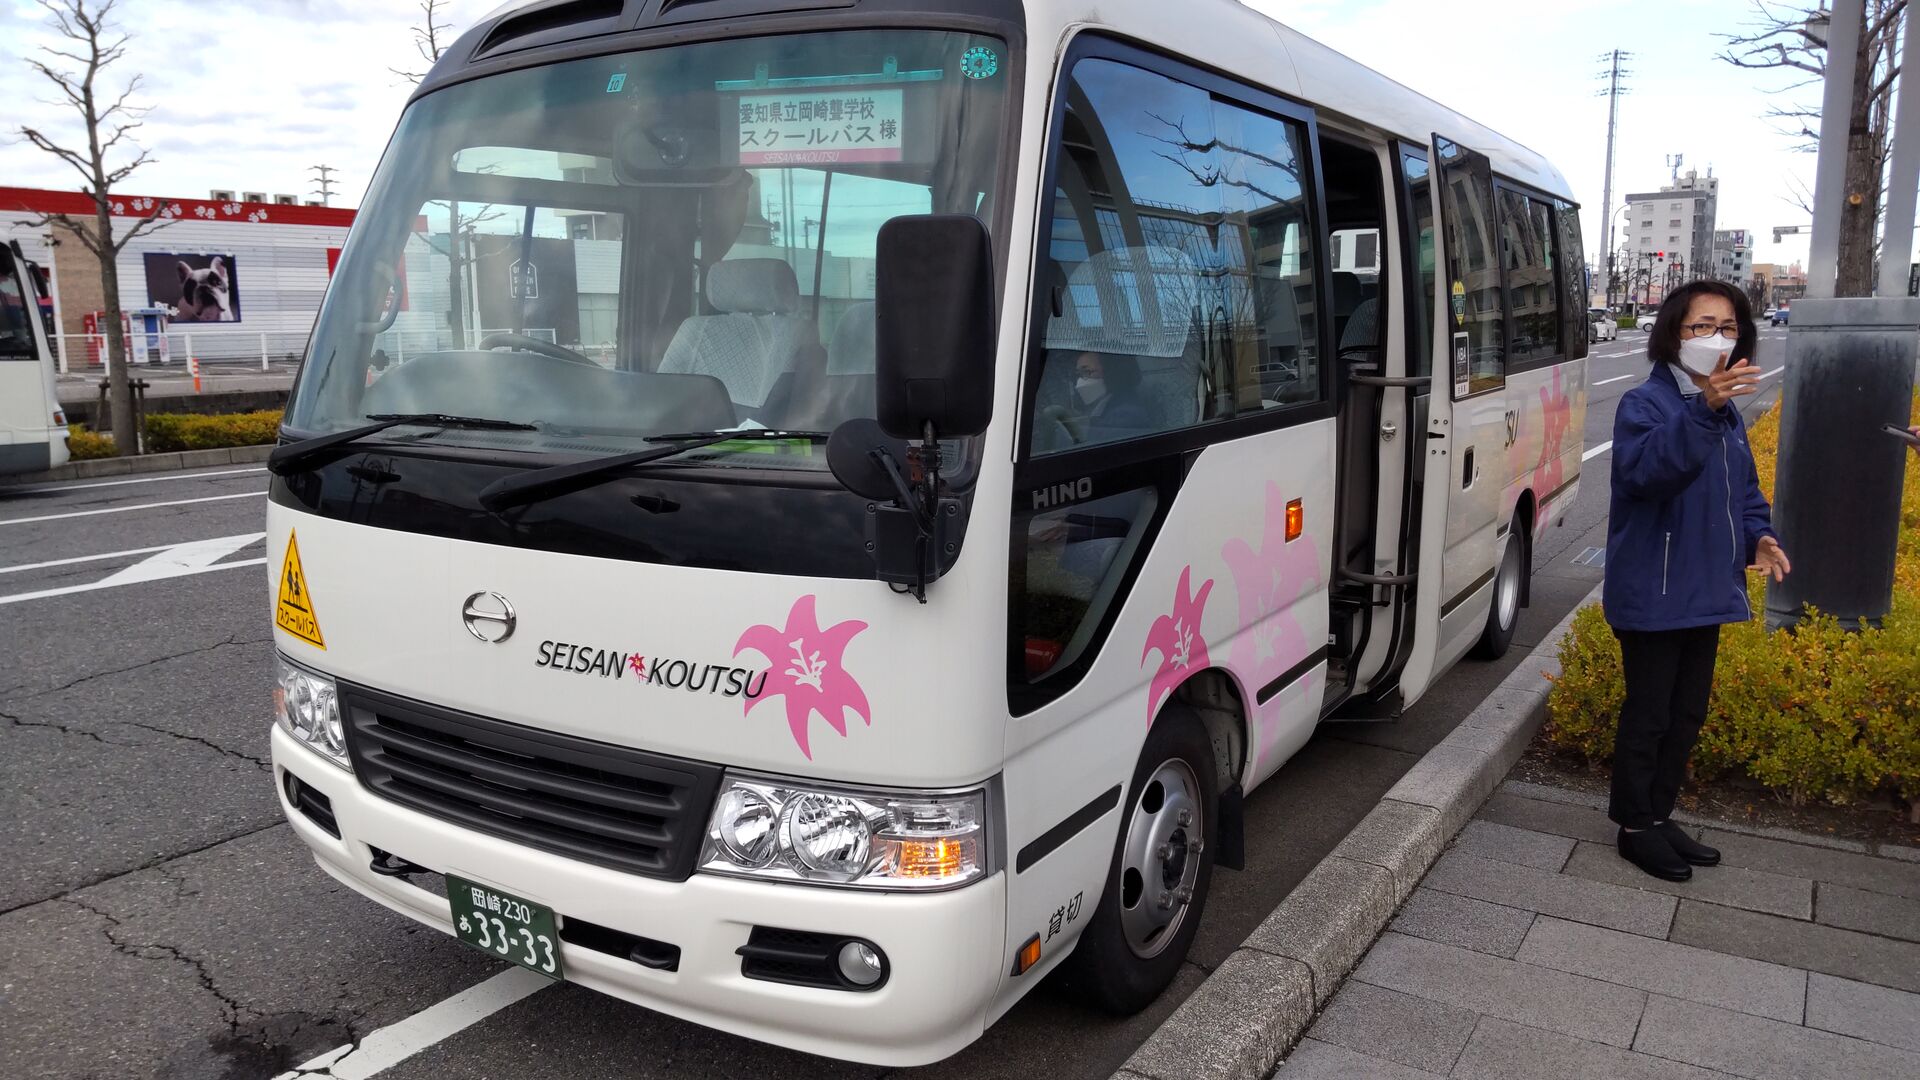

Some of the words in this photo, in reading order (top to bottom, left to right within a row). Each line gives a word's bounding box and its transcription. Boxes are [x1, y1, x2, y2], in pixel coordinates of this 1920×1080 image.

[740, 97, 876, 125] 愛知県立岡崎聾学校
[740, 124, 876, 147] スクールバス
[762, 151, 796, 164] SEISAN
[801, 151, 840, 163] KOUTSU
[1032, 476, 1092, 510] HINO
[279, 606, 316, 638] スクールバス
[535, 640, 628, 680] SEISAN
[647, 656, 768, 700] KOUTSU
[1045, 890, 1084, 944] 貸切
